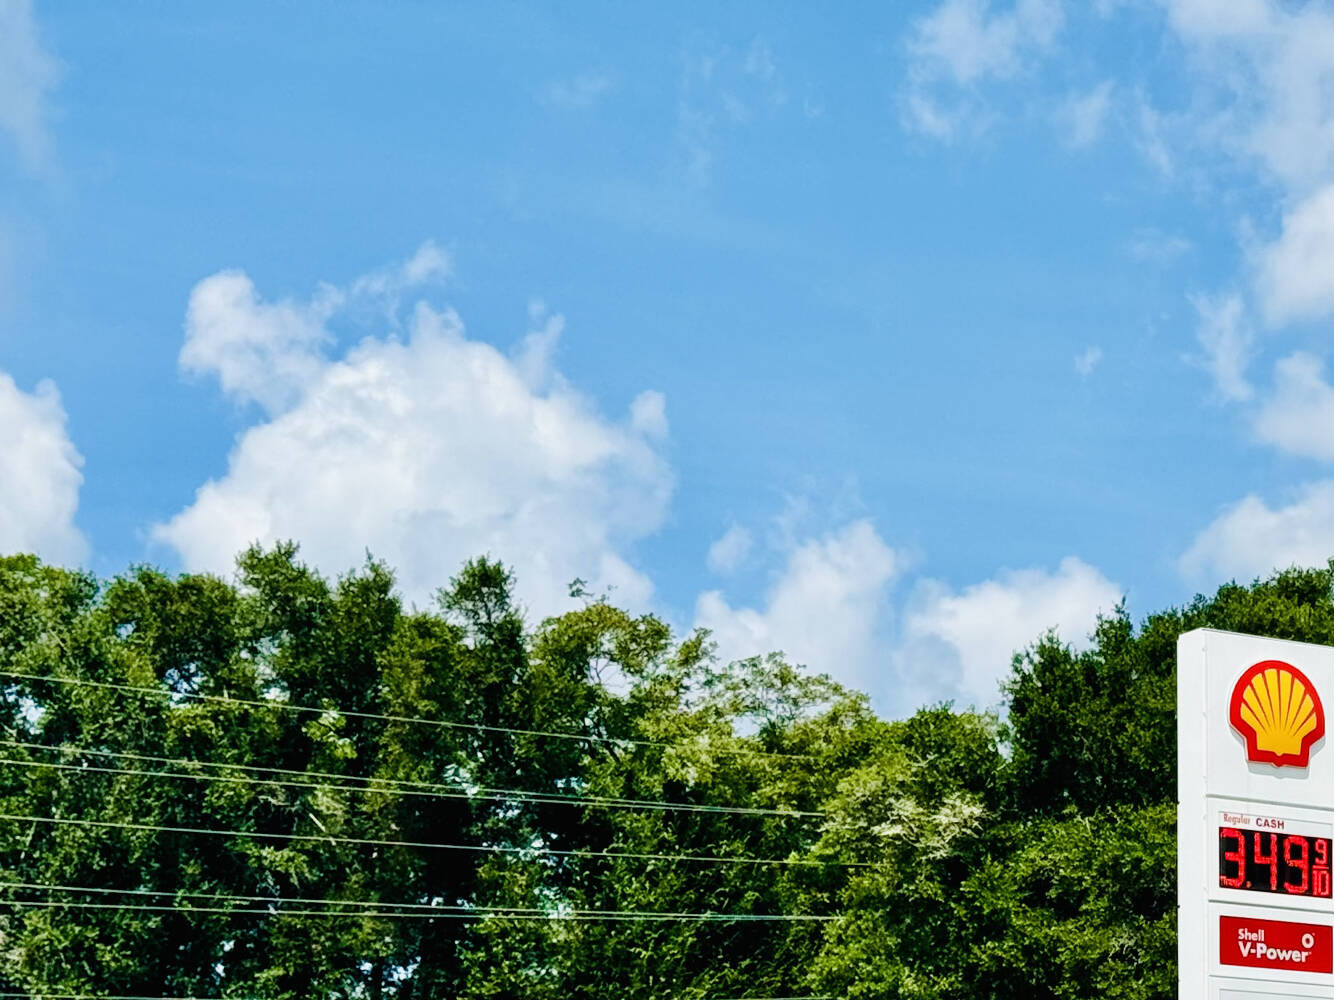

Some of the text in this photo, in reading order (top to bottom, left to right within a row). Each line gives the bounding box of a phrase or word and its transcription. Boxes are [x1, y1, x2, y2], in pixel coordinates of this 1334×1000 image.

[1256, 818, 1285, 829] CASH
[1238, 928, 1265, 942] Shell
[1238, 941, 1309, 963] V-Power
